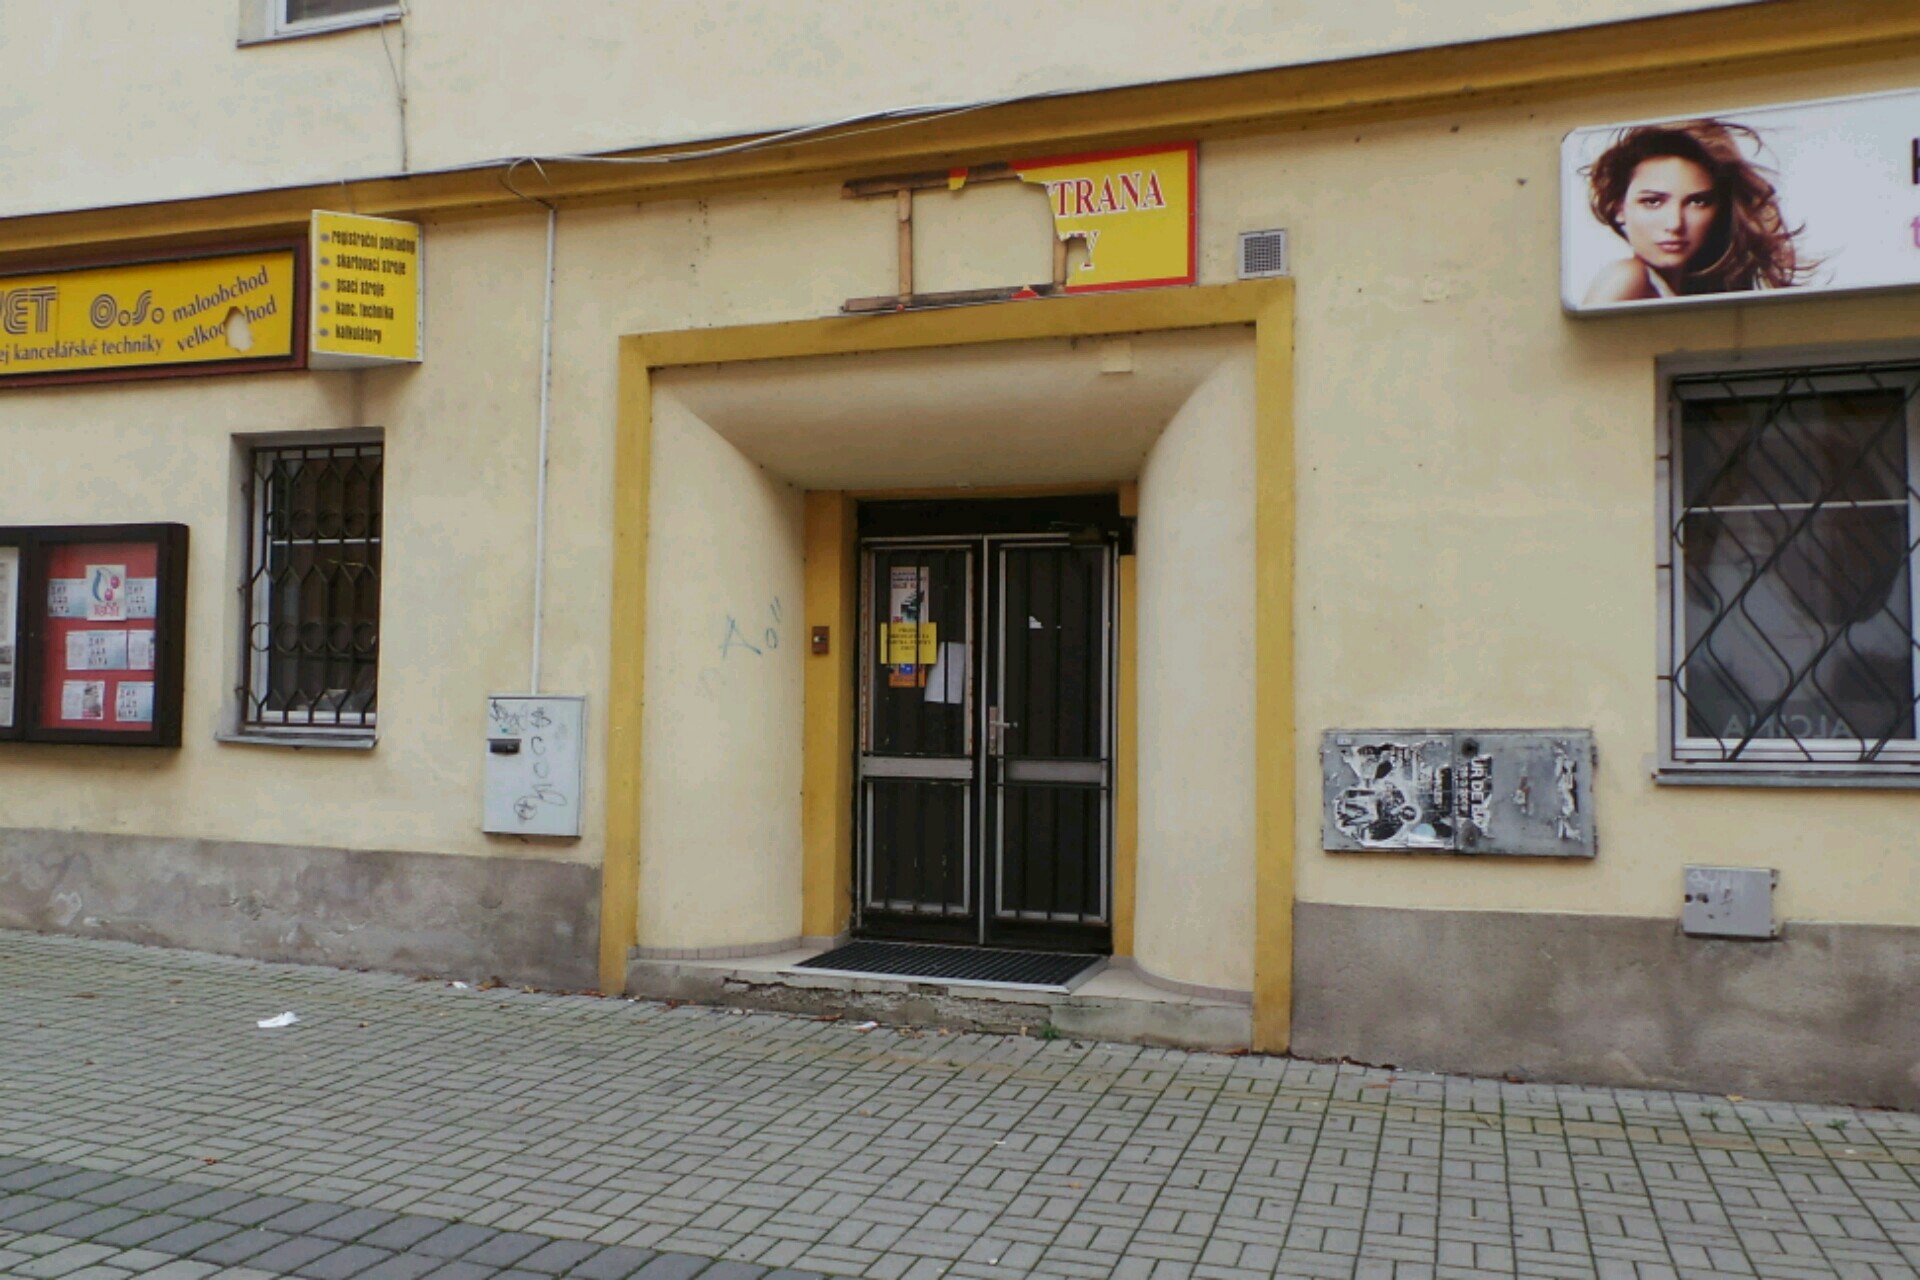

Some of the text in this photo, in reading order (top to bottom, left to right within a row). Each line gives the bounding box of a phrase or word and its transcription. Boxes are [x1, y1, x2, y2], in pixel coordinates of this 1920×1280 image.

[1045, 171, 1166, 218] TRANA
[361, 281, 385, 297] stroje
[382, 259, 407, 276] stroje
[0, 286, 56, 335] ET
[172, 263, 269, 323] maloobchod
[177, 293, 277, 352] velkoohod
[14, 338, 98, 361] kancelářské
[102, 333, 163, 356] techniky
